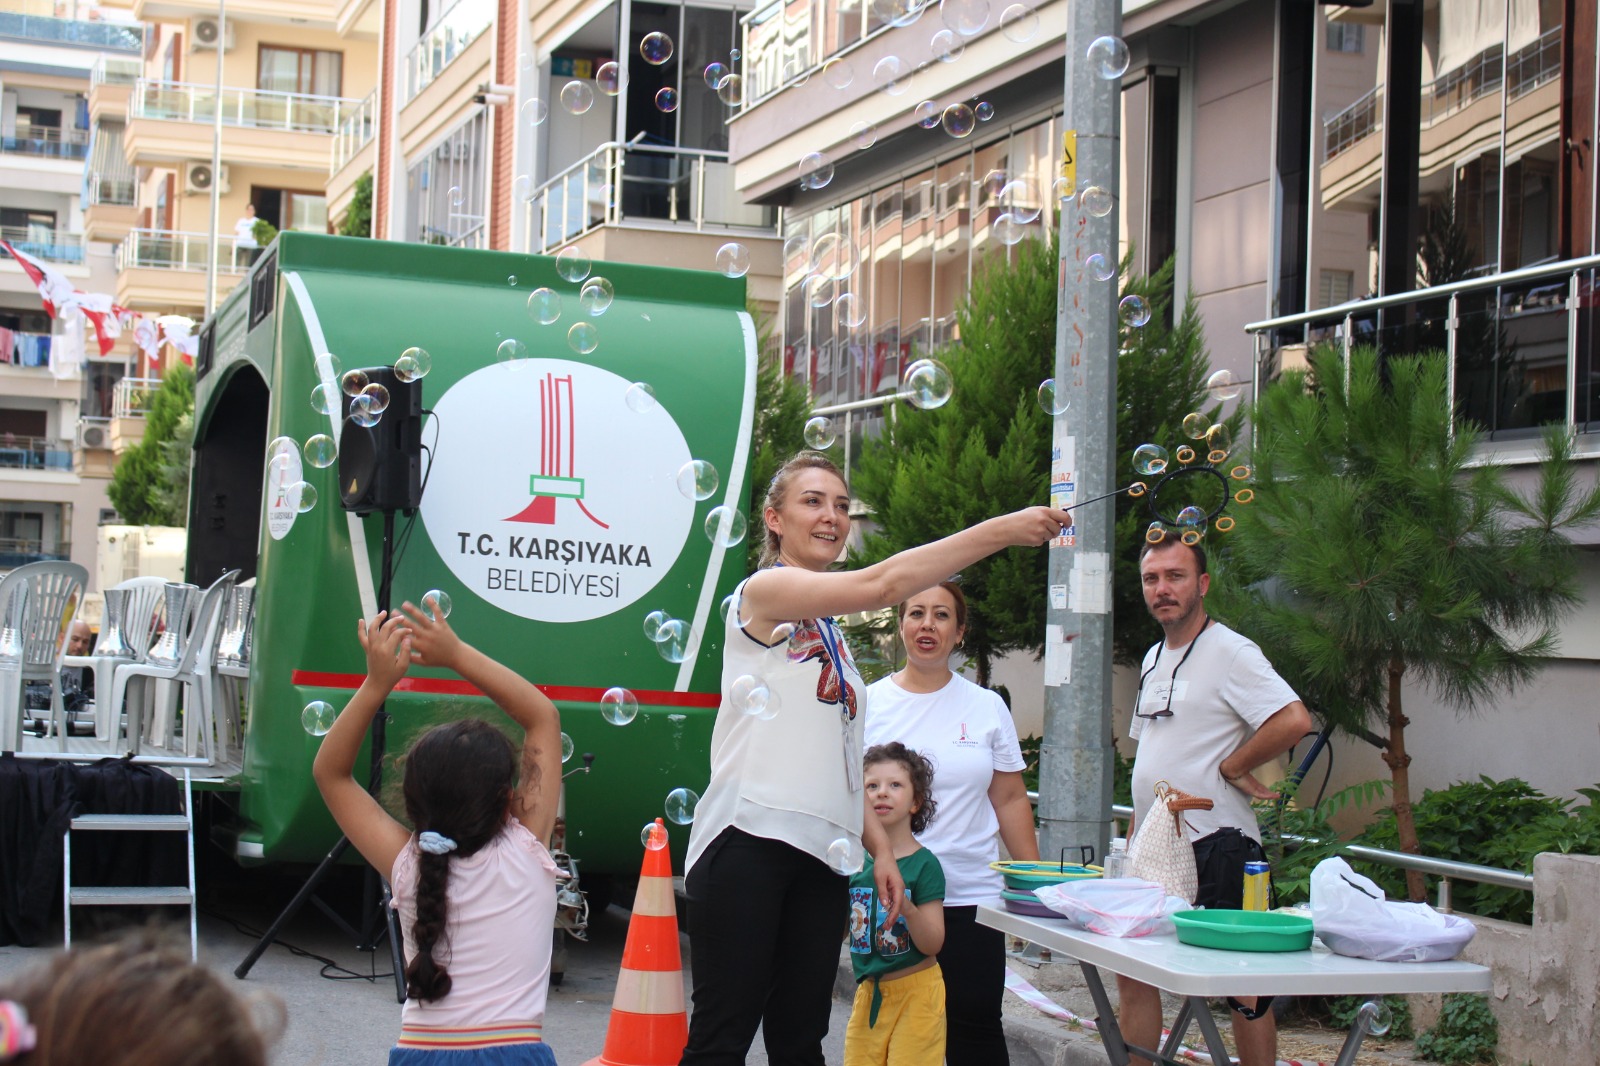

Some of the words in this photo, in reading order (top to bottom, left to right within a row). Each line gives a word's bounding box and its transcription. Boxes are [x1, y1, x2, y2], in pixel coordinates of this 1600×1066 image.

[457, 532, 500, 557] T.C.
[509, 535, 652, 568] KARŞIYAKA
[487, 567, 620, 598] BELEDİYESİ
